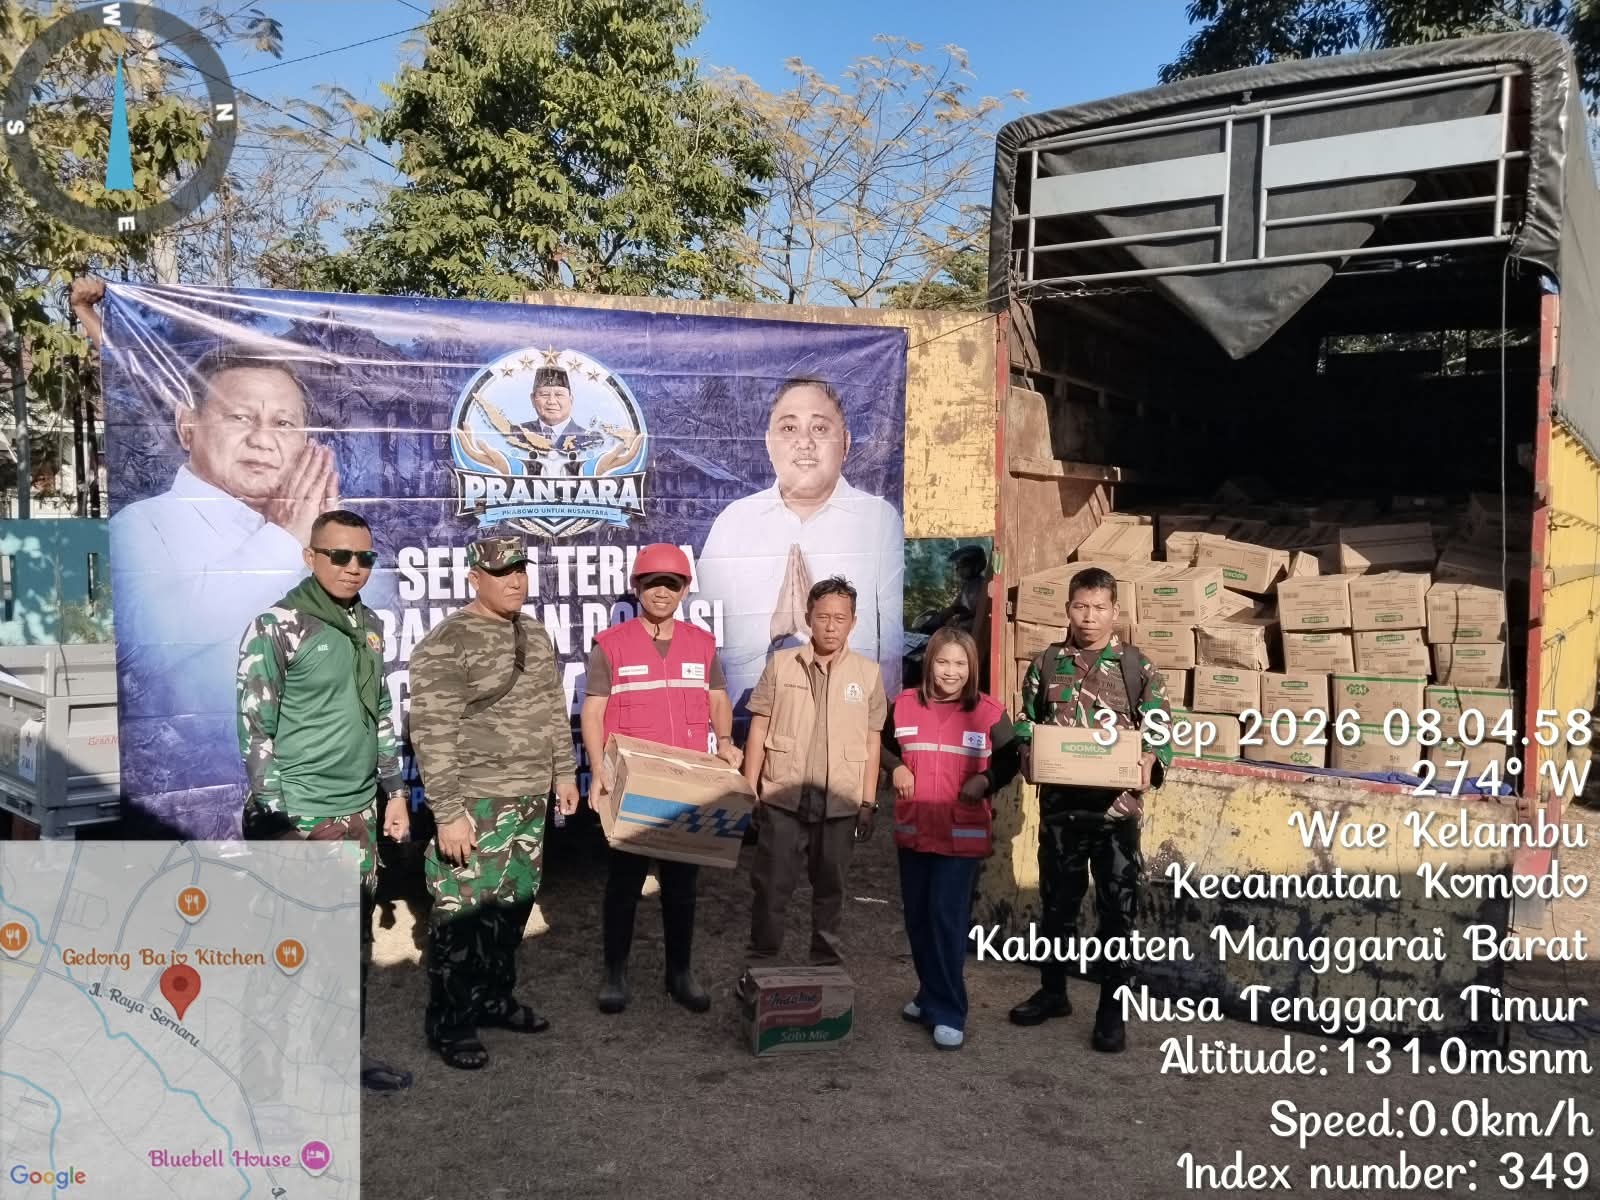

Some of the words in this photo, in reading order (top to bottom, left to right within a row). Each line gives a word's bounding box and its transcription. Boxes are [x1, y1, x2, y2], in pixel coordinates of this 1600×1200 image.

[464, 474, 639, 511] PRANTARA
[502, 508, 540, 516] PRABOWO
[567, 507, 609, 516] NUSANTARA
[398, 546, 540, 601] SER
